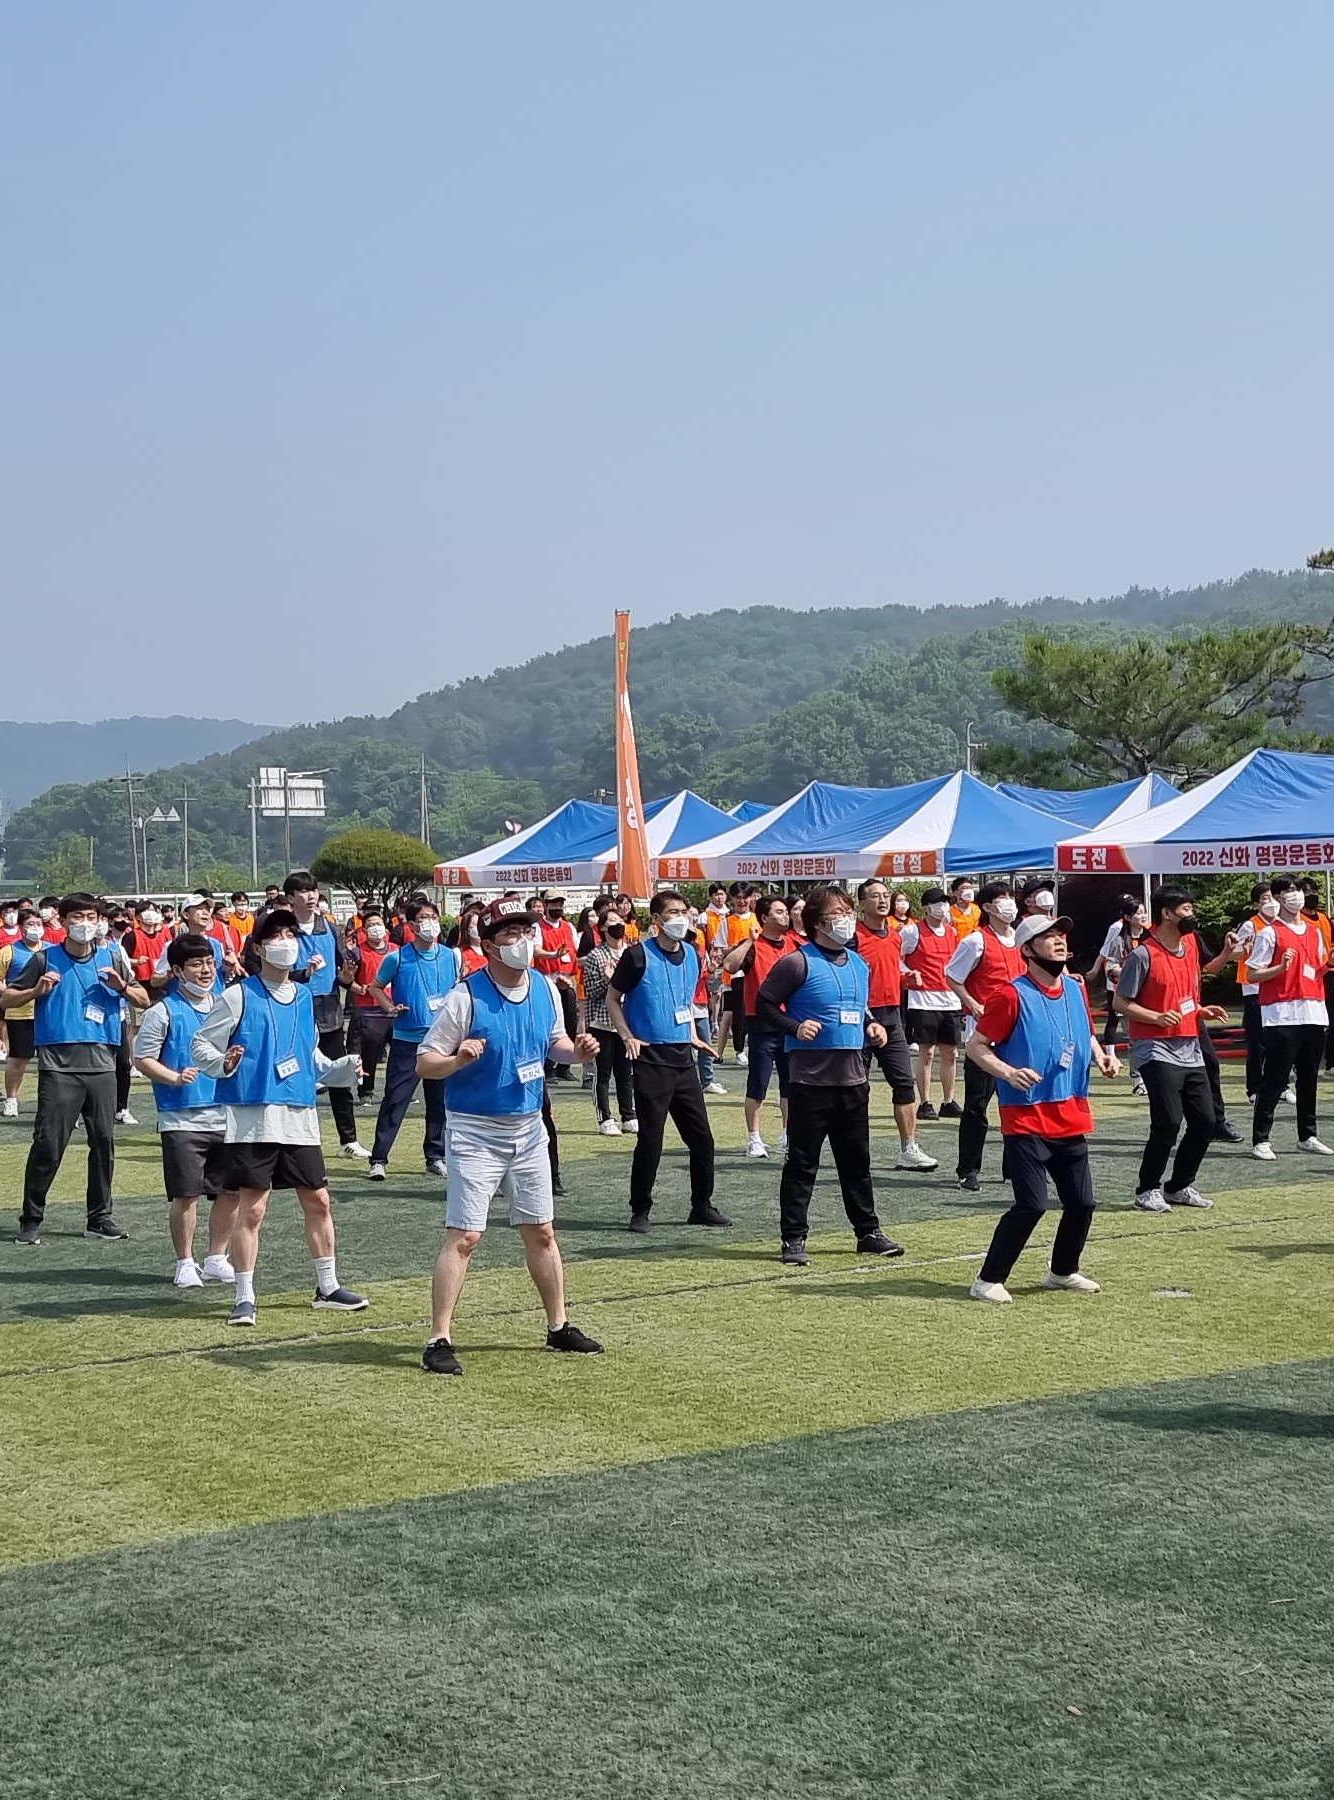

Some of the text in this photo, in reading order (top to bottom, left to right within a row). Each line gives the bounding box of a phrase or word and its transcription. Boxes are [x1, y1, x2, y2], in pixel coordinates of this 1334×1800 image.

[736, 857, 836, 877] 2022 신화 명랑운동회
[892, 852, 922, 874] 열정
[1070, 847, 1108, 870] 도전
[1181, 850, 1215, 867] 2022
[1218, 845, 1250, 868] 신화
[666, 858, 691, 878] 열정
